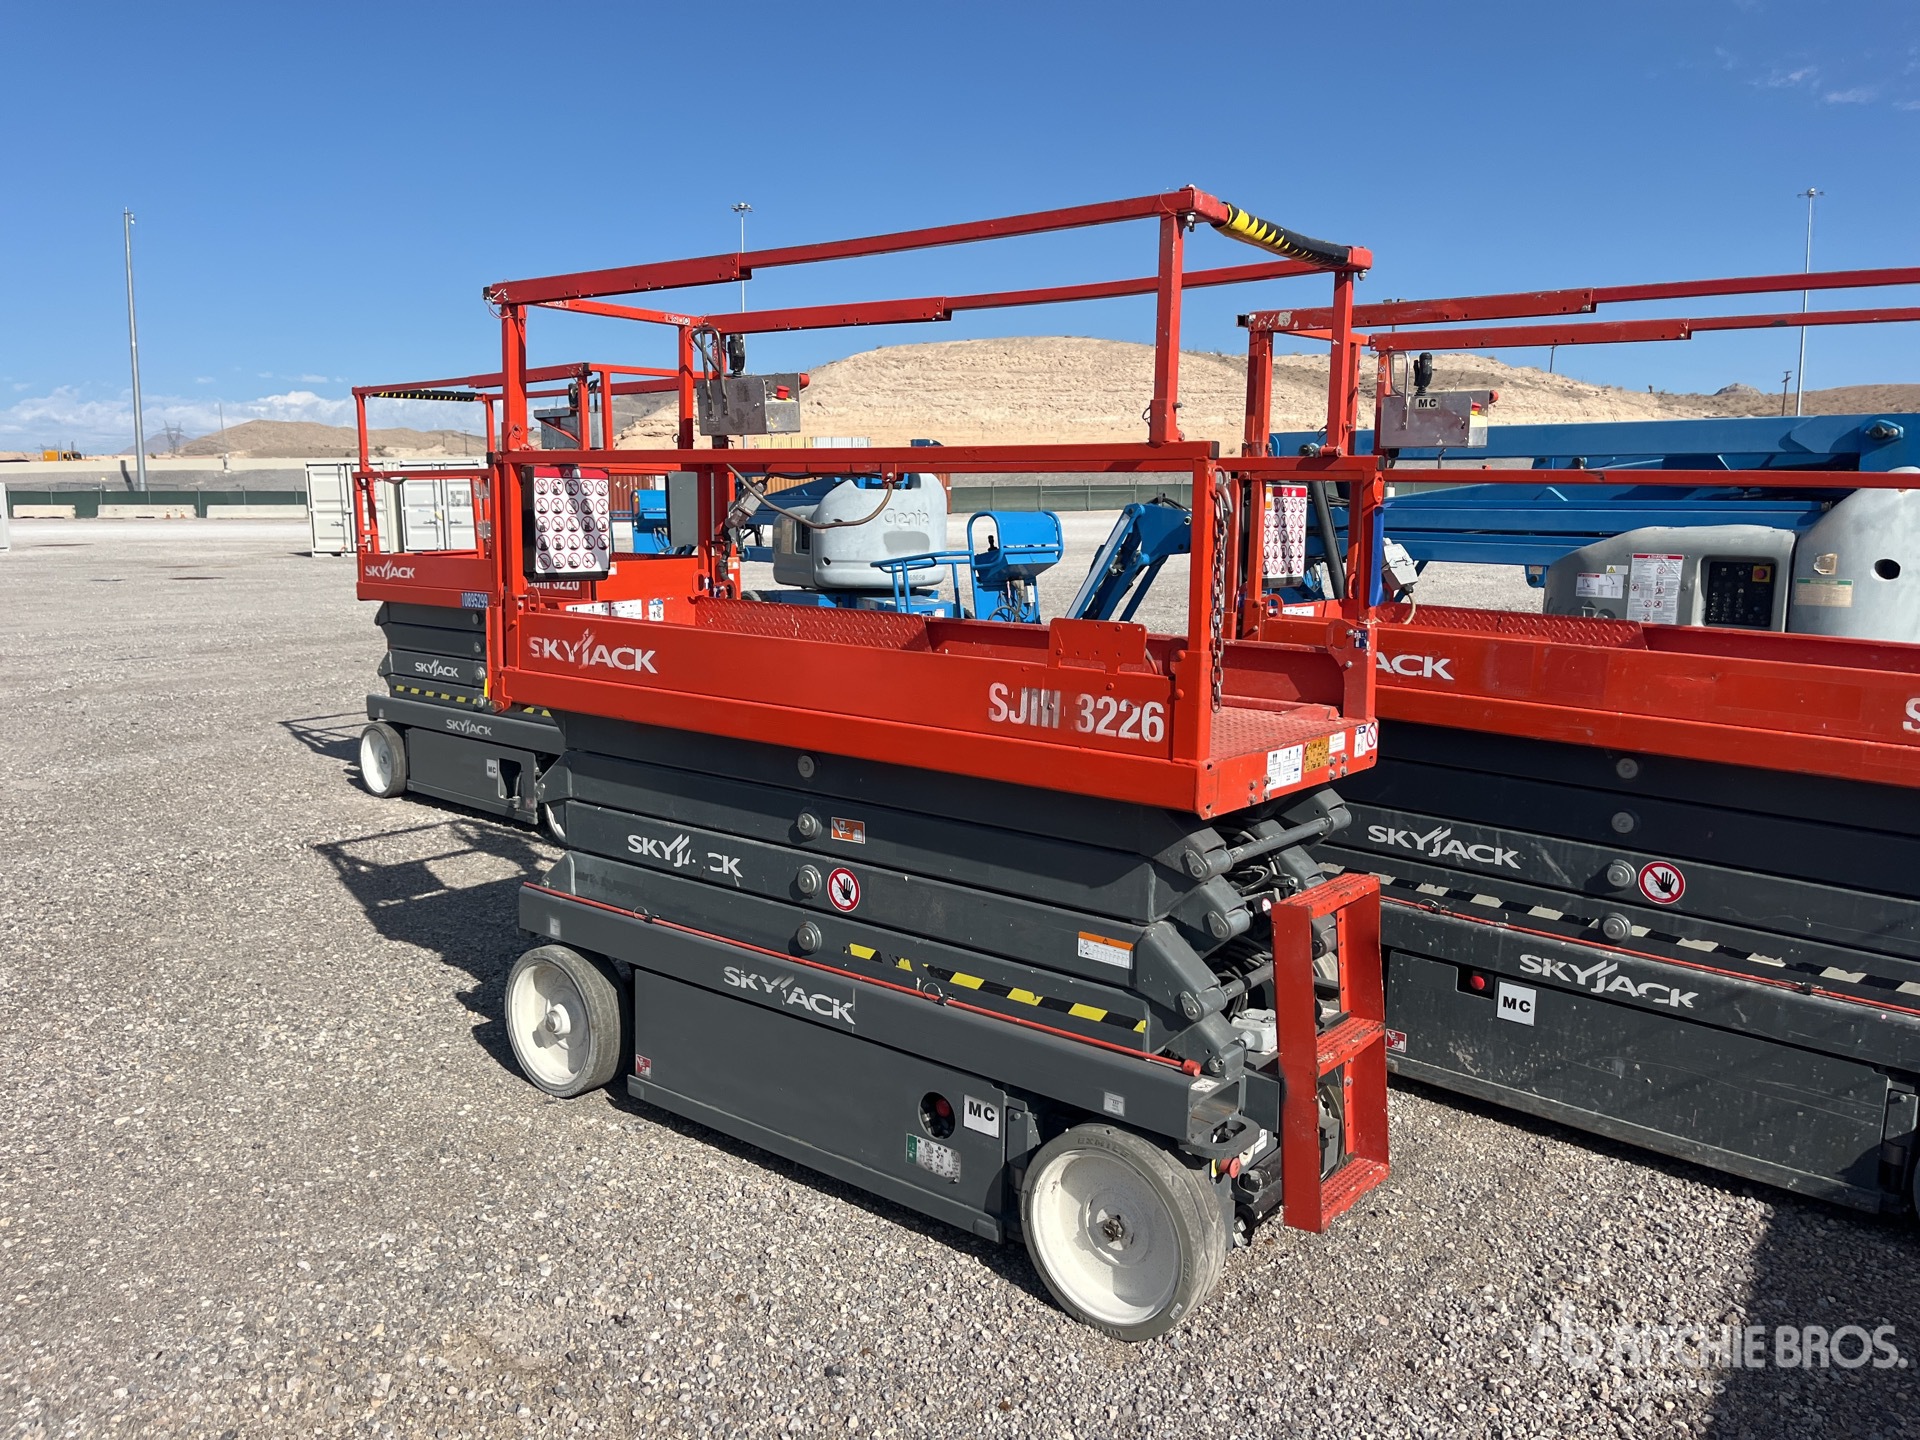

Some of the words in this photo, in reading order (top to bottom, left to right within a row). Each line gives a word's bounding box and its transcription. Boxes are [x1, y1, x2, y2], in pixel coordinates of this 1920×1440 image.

[1418, 398, 1437, 408] MC
[883, 507, 930, 526] Genie
[365, 560, 416, 579] SKYJACK
[527, 628, 658, 674] SKYJACK
[415, 659, 459, 677] SKYJACK
[446, 719, 492, 736] SKYJACK
[1074, 693, 1165, 743] 3226
[1368, 826, 1521, 869] SKYJACK
[1519, 954, 1699, 1008] SKYJACK
[1503, 997, 1531, 1013] MC
[968, 1101, 996, 1122] MC
